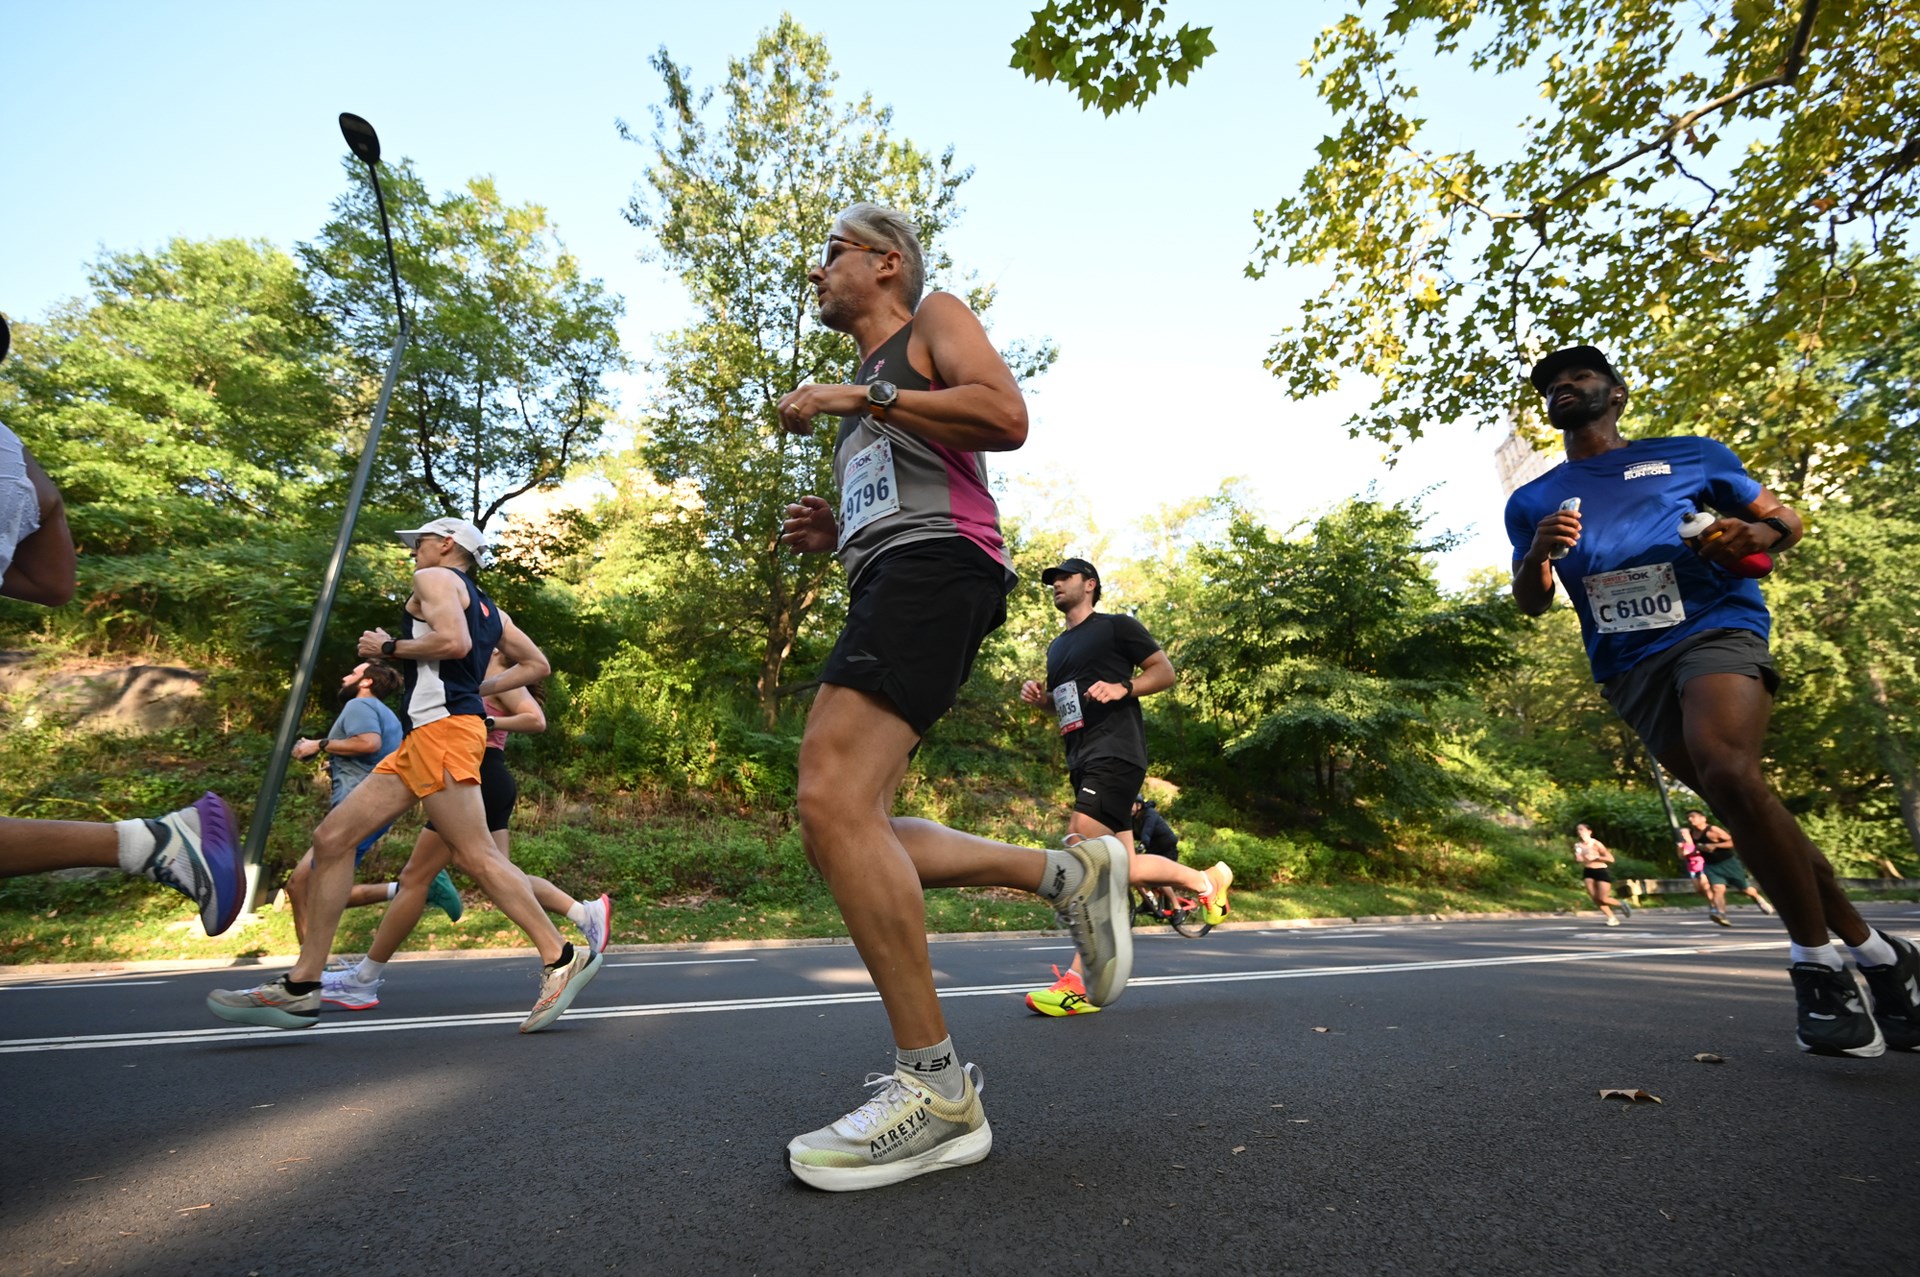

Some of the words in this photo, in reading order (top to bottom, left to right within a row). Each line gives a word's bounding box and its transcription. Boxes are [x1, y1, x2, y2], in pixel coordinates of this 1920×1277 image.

[846, 476, 890, 521] 9796
[1628, 571, 1649, 582] 10K
[1601, 604, 1613, 623] C
[1616, 595, 1672, 619] 6100
[870, 1107, 927, 1153] ATREYU
[872, 1140, 903, 1160] RUNNING
[903, 1117, 932, 1142] COMPANY
